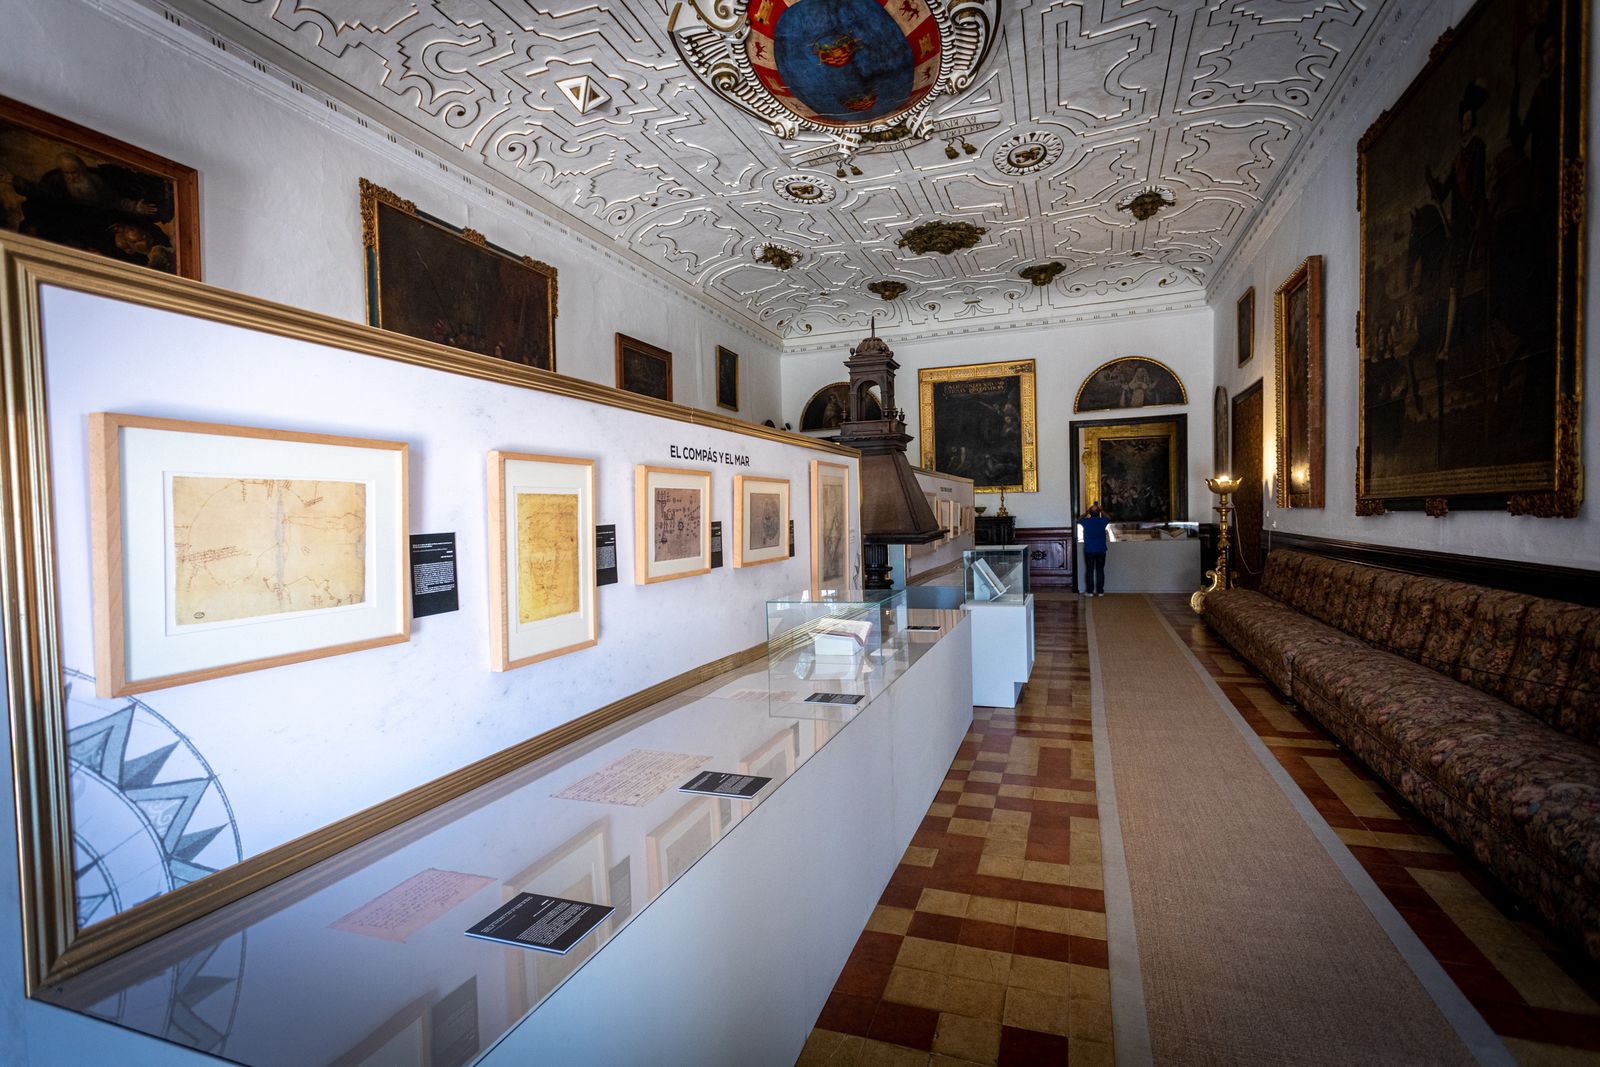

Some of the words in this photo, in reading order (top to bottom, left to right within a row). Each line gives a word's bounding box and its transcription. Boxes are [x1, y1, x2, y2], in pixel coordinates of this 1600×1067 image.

[670, 445, 681, 458] EL
[683, 447, 717, 462] COMPÁS
[719, 452, 724, 463] Y
[725, 453, 733, 464] EL
[734, 454, 749, 466] MAR
